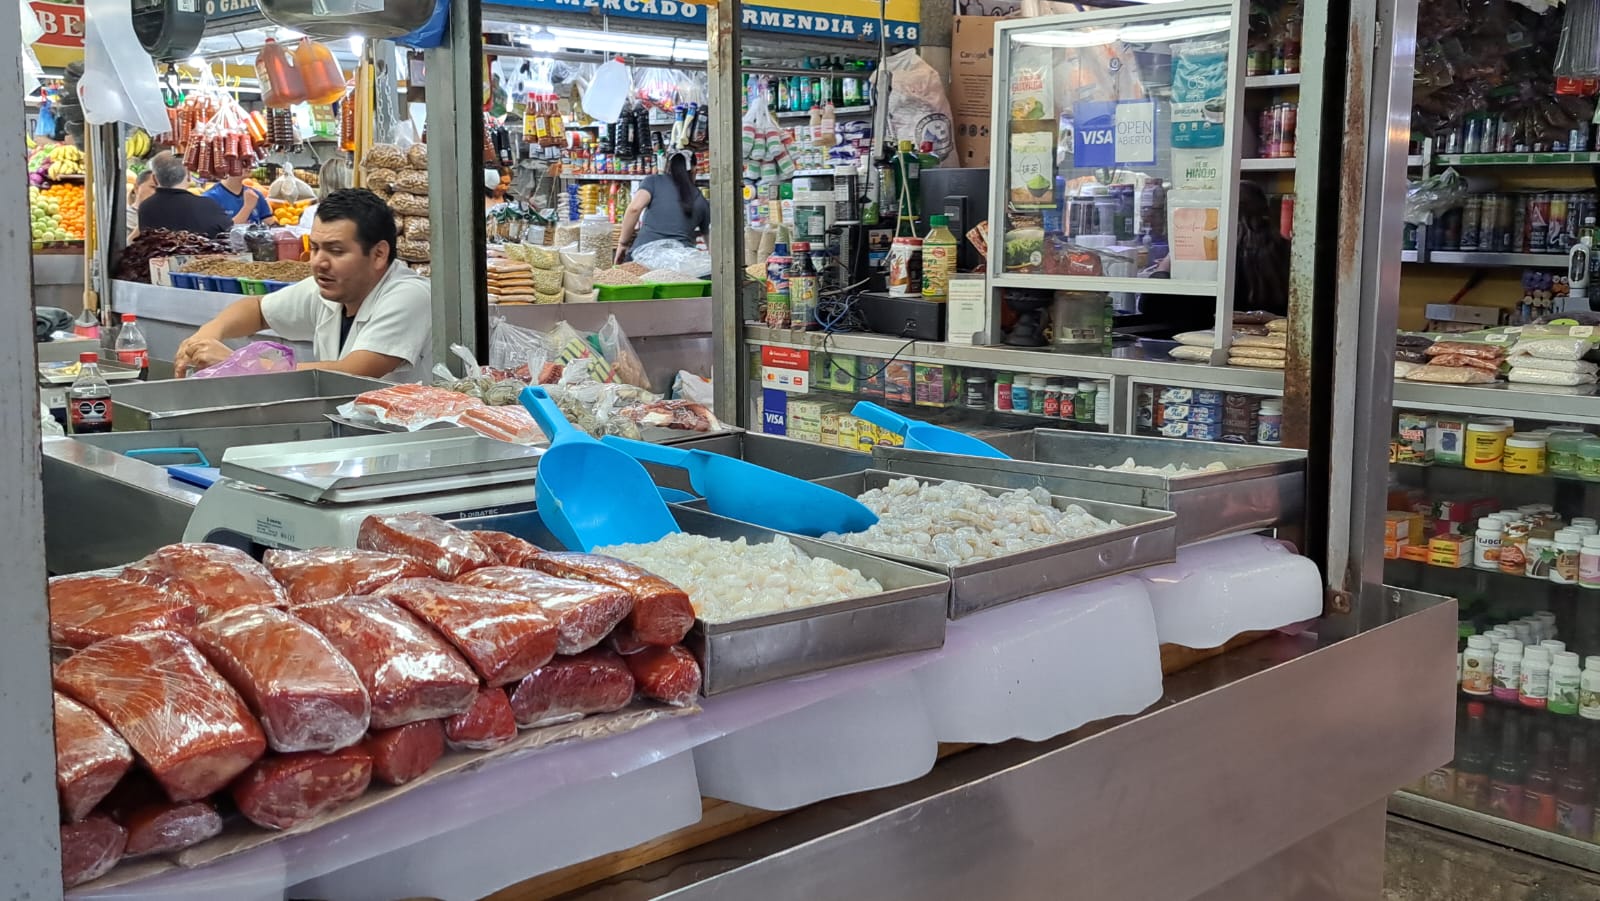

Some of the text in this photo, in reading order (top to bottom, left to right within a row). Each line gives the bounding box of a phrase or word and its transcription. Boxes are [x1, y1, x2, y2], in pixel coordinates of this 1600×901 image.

[742, 9, 918, 40] RMENDIA # 148
[1118, 120, 1152, 134] OPEN
[1080, 130, 1113, 145] VISA
[1118, 135, 1152, 145] ABIERTO
[765, 412, 784, 425] VISA
